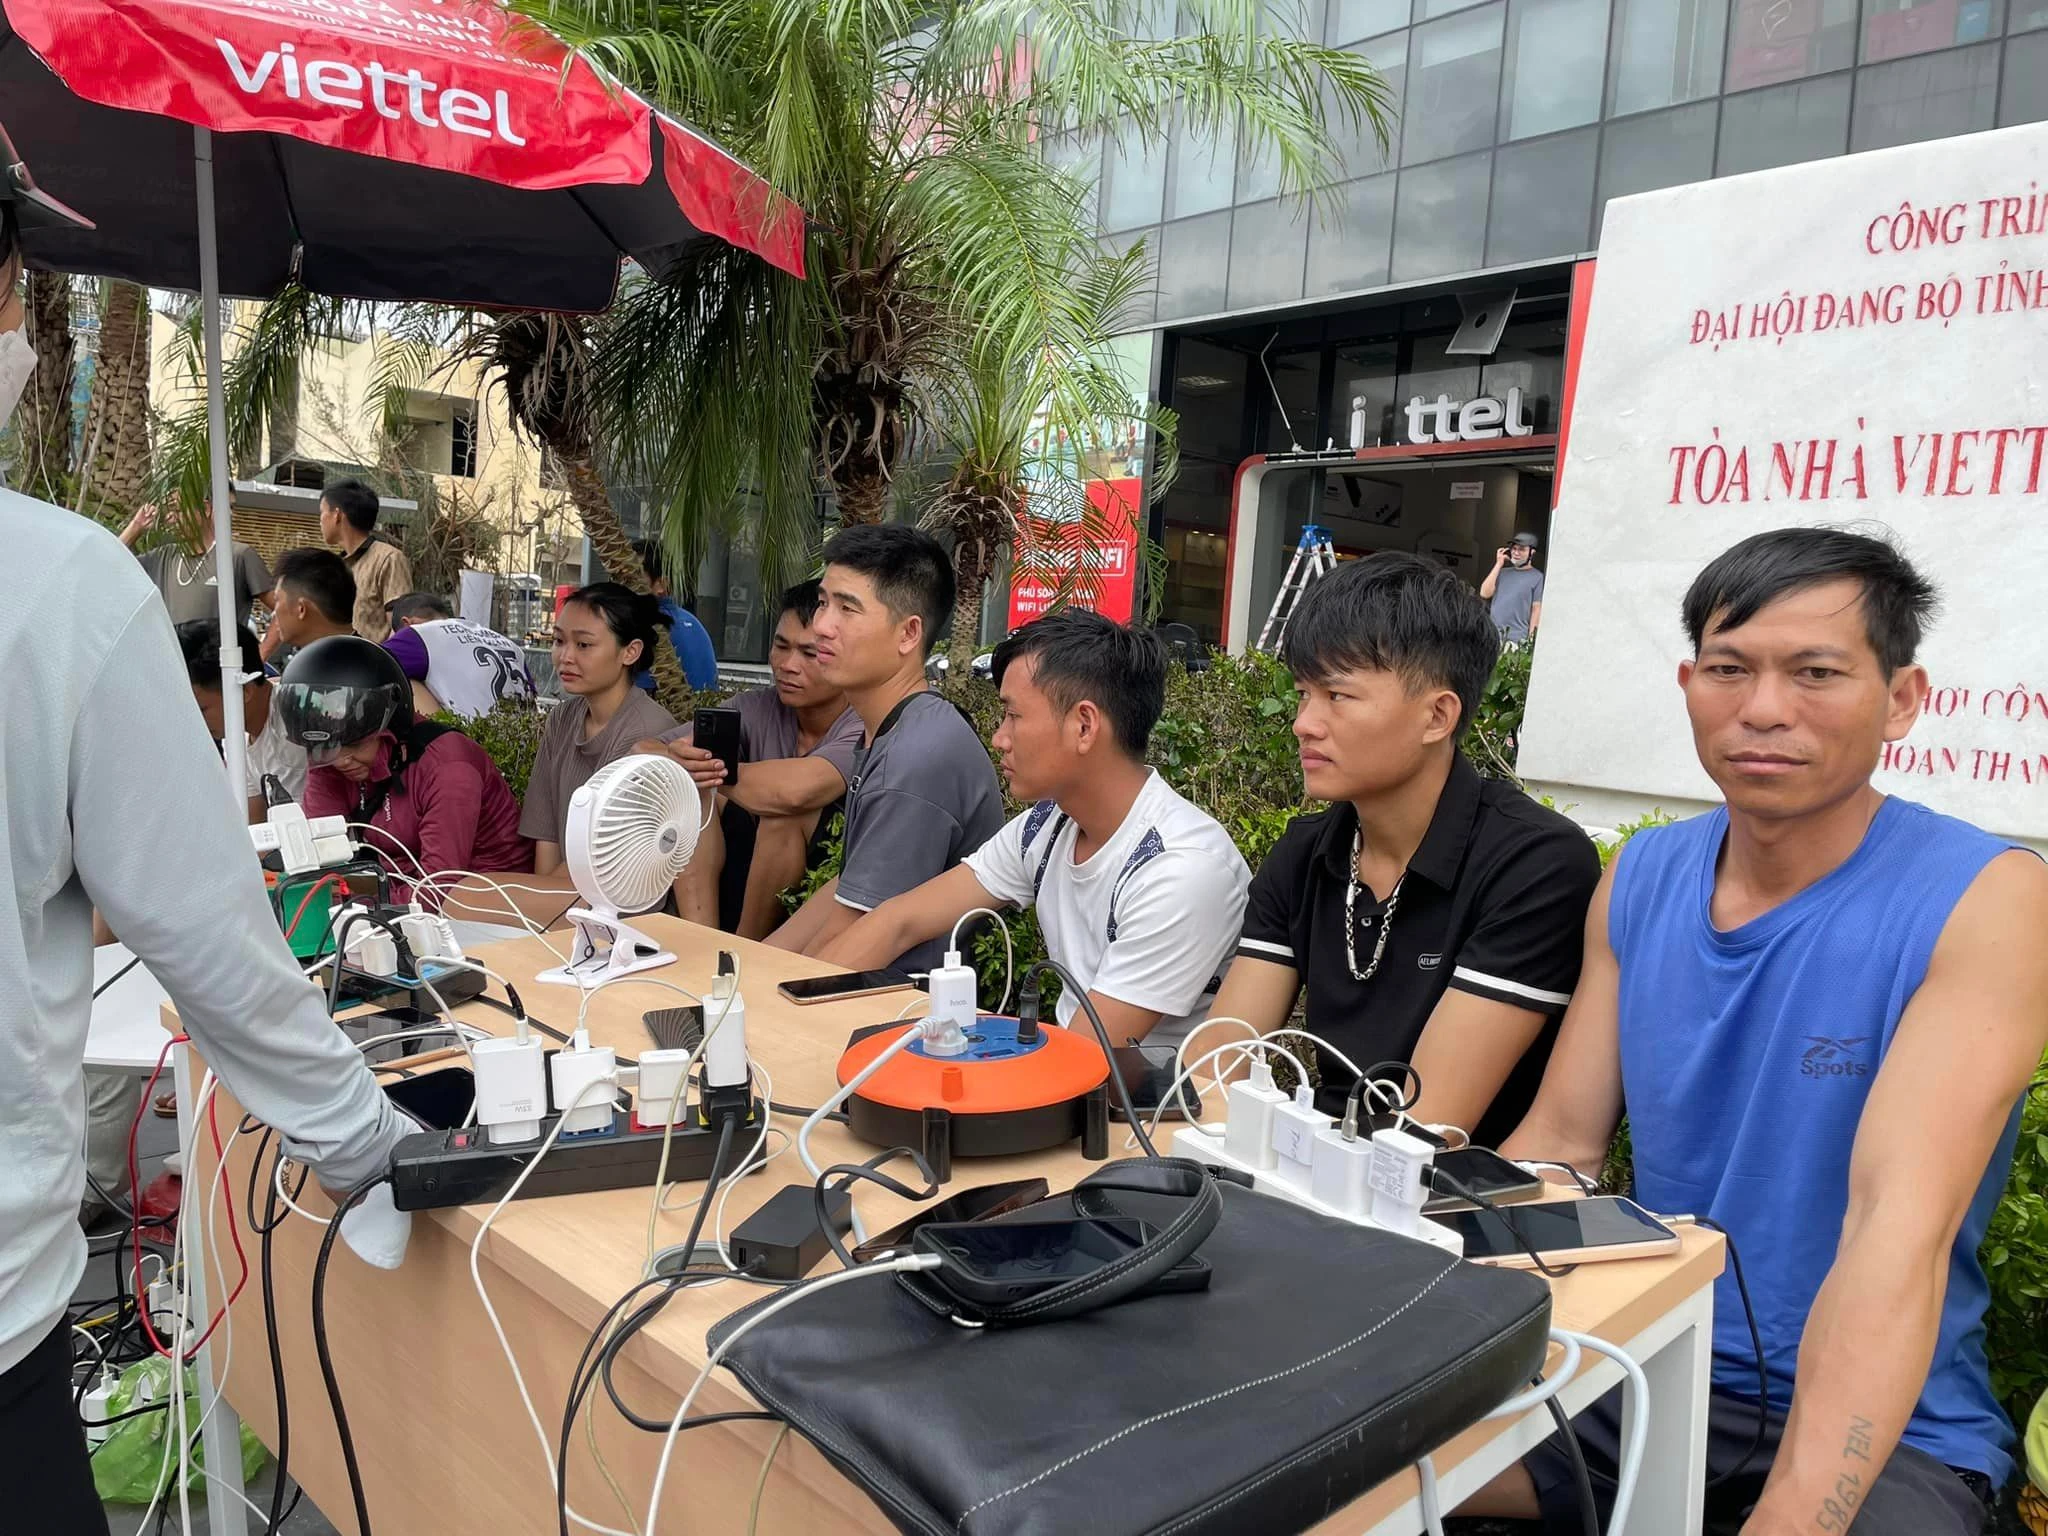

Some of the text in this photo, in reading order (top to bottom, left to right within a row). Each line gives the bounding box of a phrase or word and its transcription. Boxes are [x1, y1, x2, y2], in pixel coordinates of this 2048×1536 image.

[215, 38, 526, 147] viettel
[1866, 201, 1967, 254] CÔNG
[1689, 303, 1743, 352] ĐẠI
[1748, 290, 1808, 345] HỘI
[1915, 272, 1962, 328] BỘ
[1668, 427, 1750, 504] TÒA
[1764, 416, 1868, 501] NHÀ
[1017, 602, 1036, 612] WIFI
[1800, 1059, 1868, 1079] Spots
